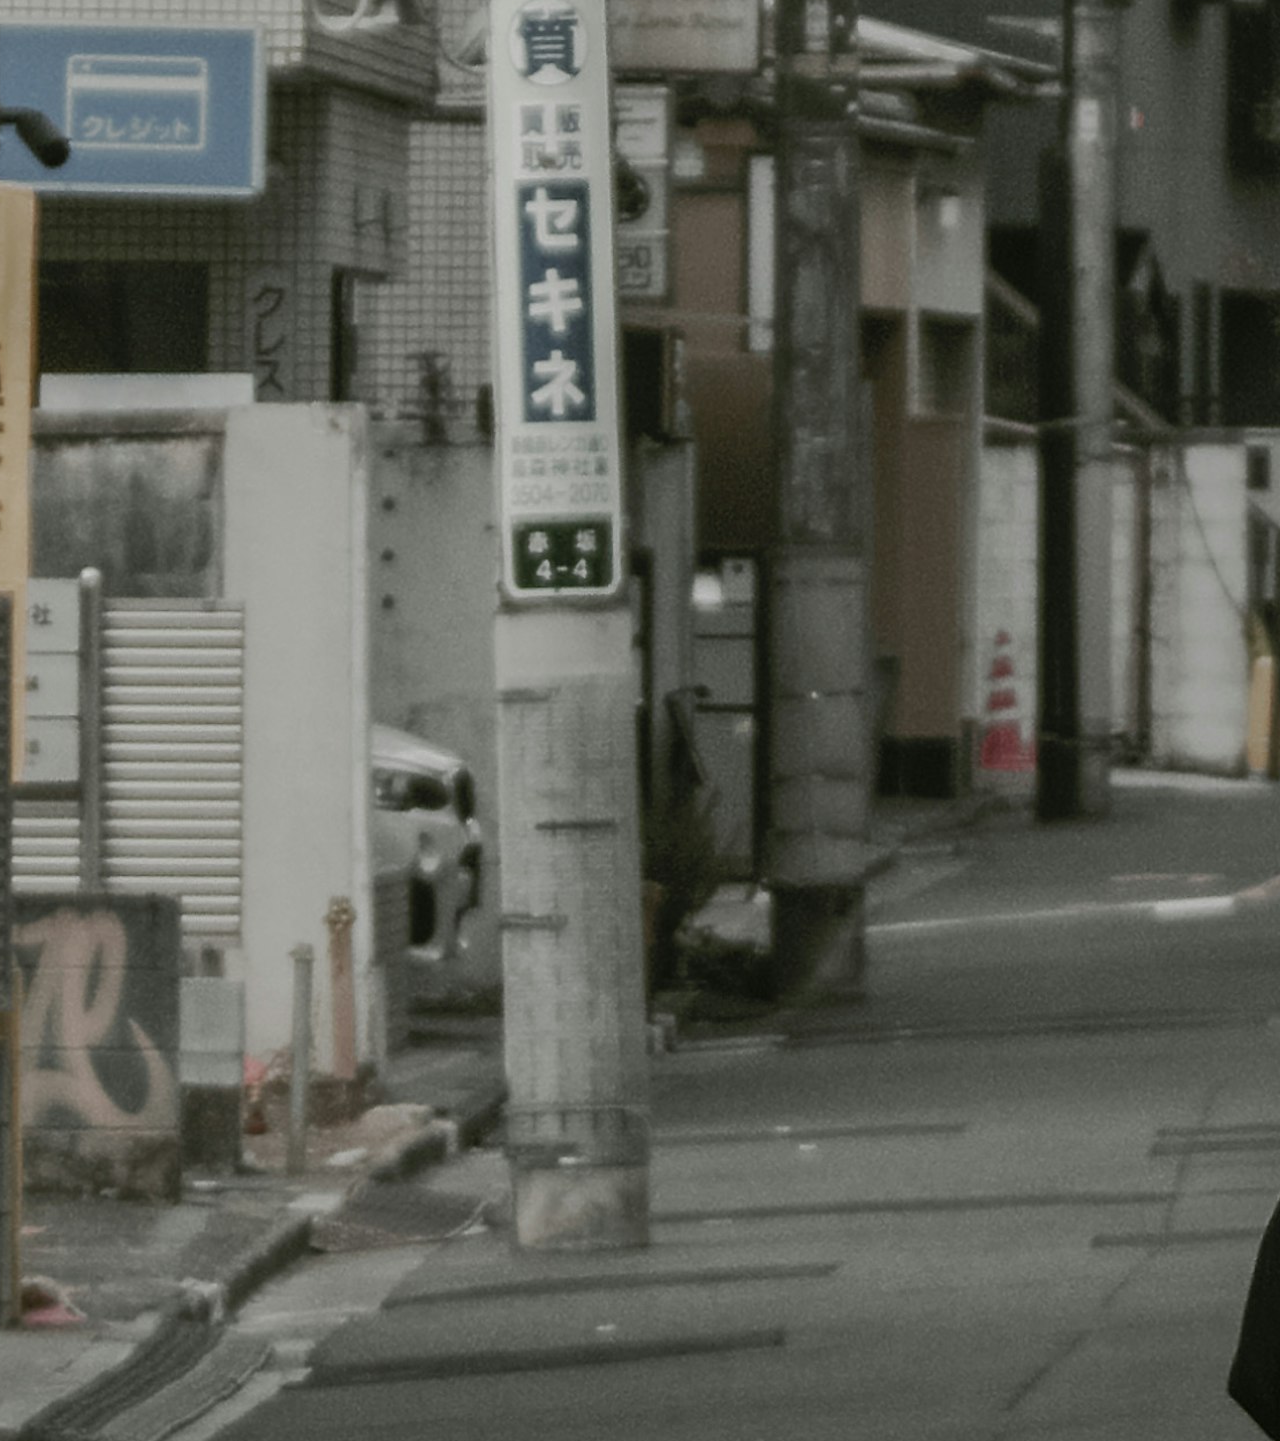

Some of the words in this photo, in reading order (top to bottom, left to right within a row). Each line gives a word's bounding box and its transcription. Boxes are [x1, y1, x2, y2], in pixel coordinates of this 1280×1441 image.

[518, 7, 581, 78] 質
[82, 115, 193, 141] クレジット
[524, 185, 585, 417] セキネ
[535, 558, 589, 581] 4-4
